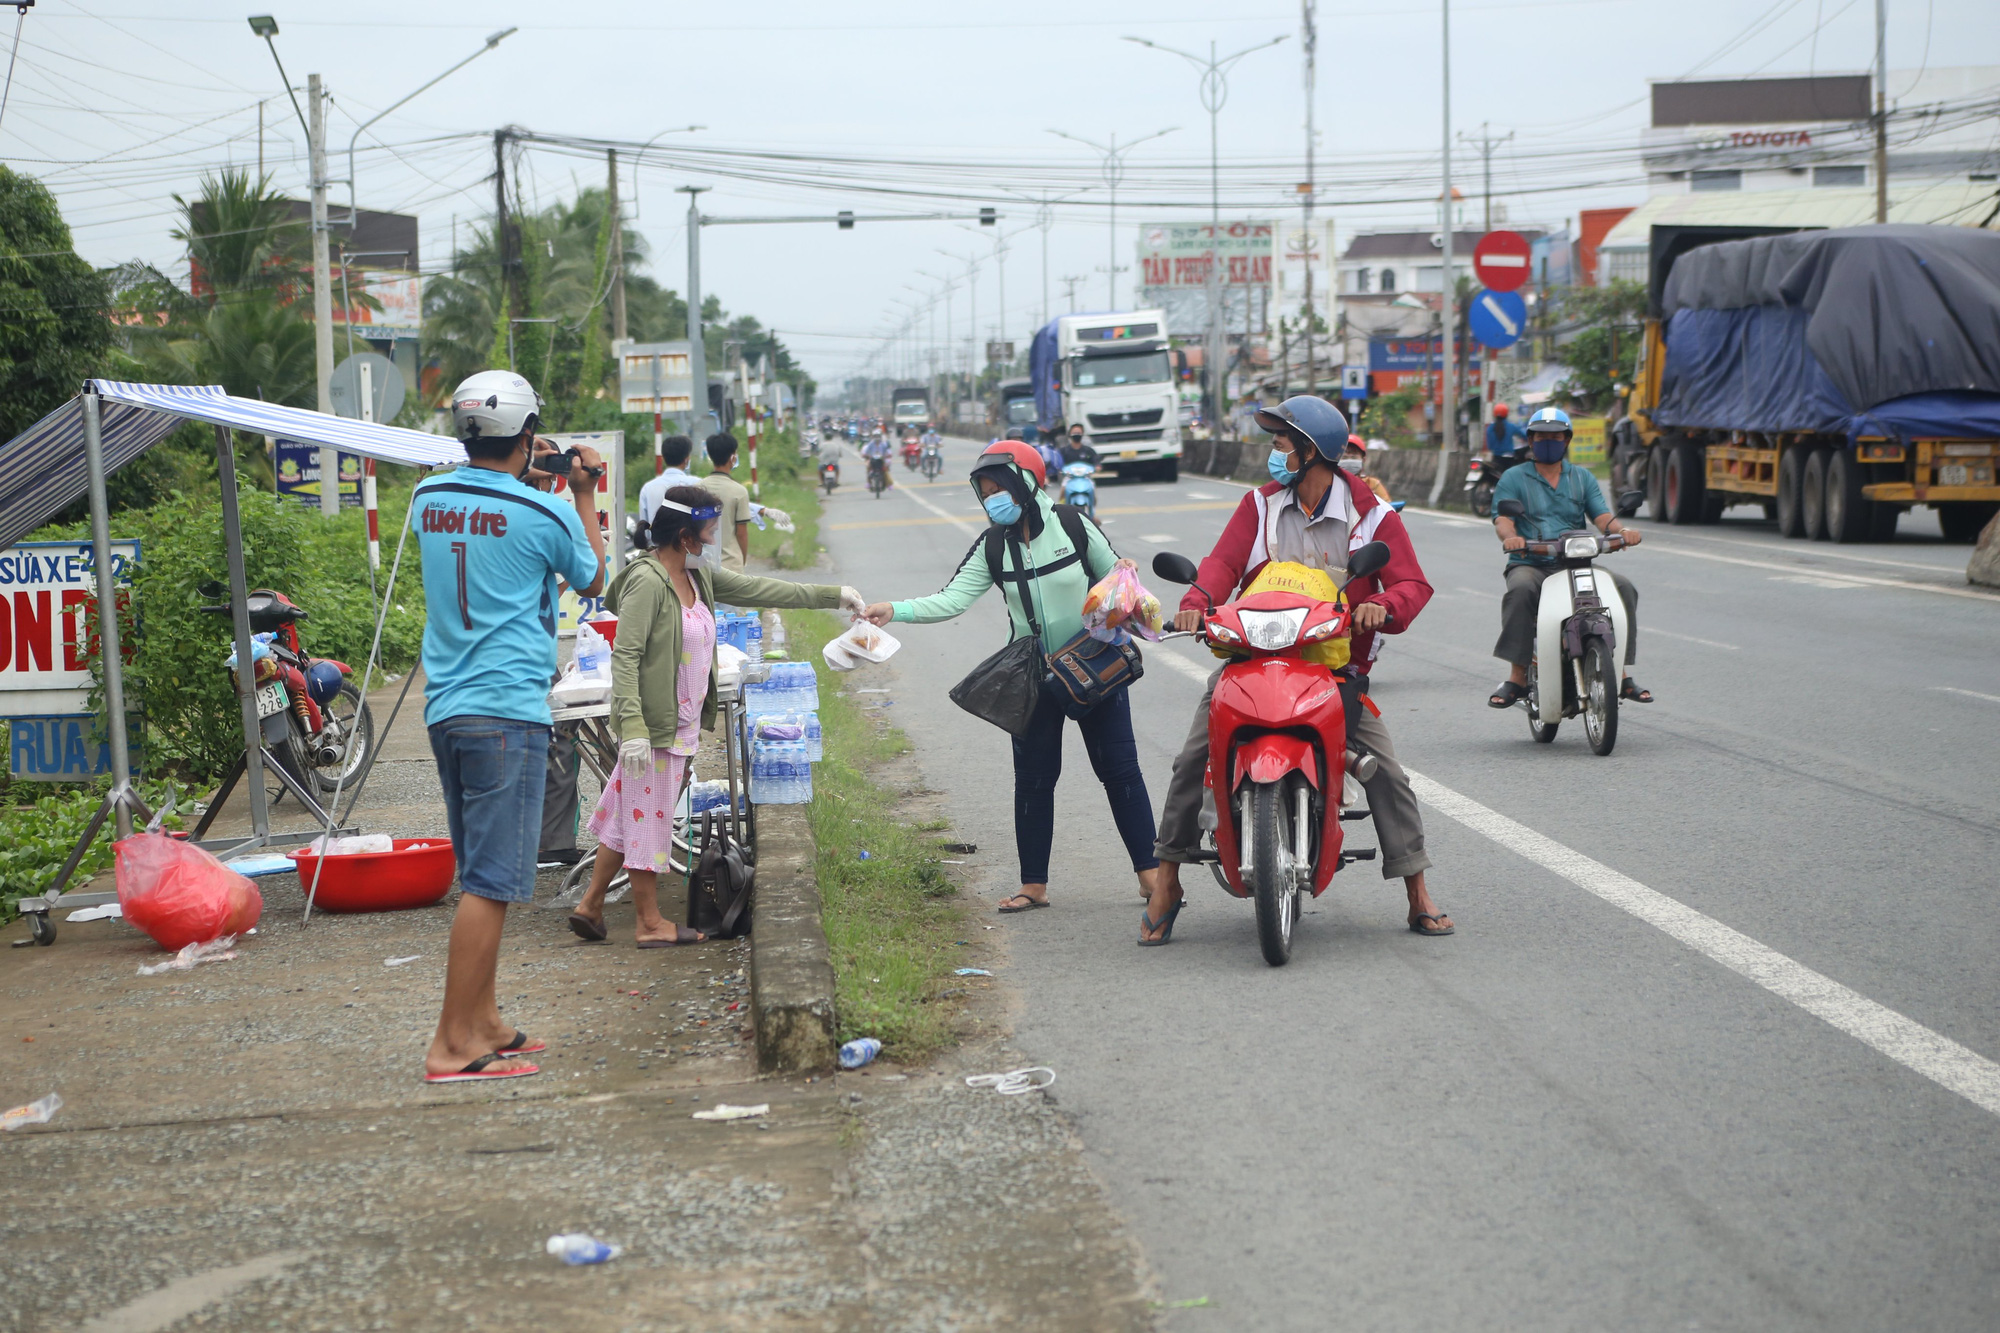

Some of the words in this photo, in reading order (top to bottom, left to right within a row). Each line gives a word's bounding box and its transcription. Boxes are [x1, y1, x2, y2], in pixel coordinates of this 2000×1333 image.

[1730, 130, 1812, 148] TOYOTA
[421, 502, 467, 535] tuổi
[468, 505, 508, 538] trẻ
[44, 555, 81, 583] XE
[451, 541, 473, 630] 1
[1268, 576, 1306, 591] CHÙA
